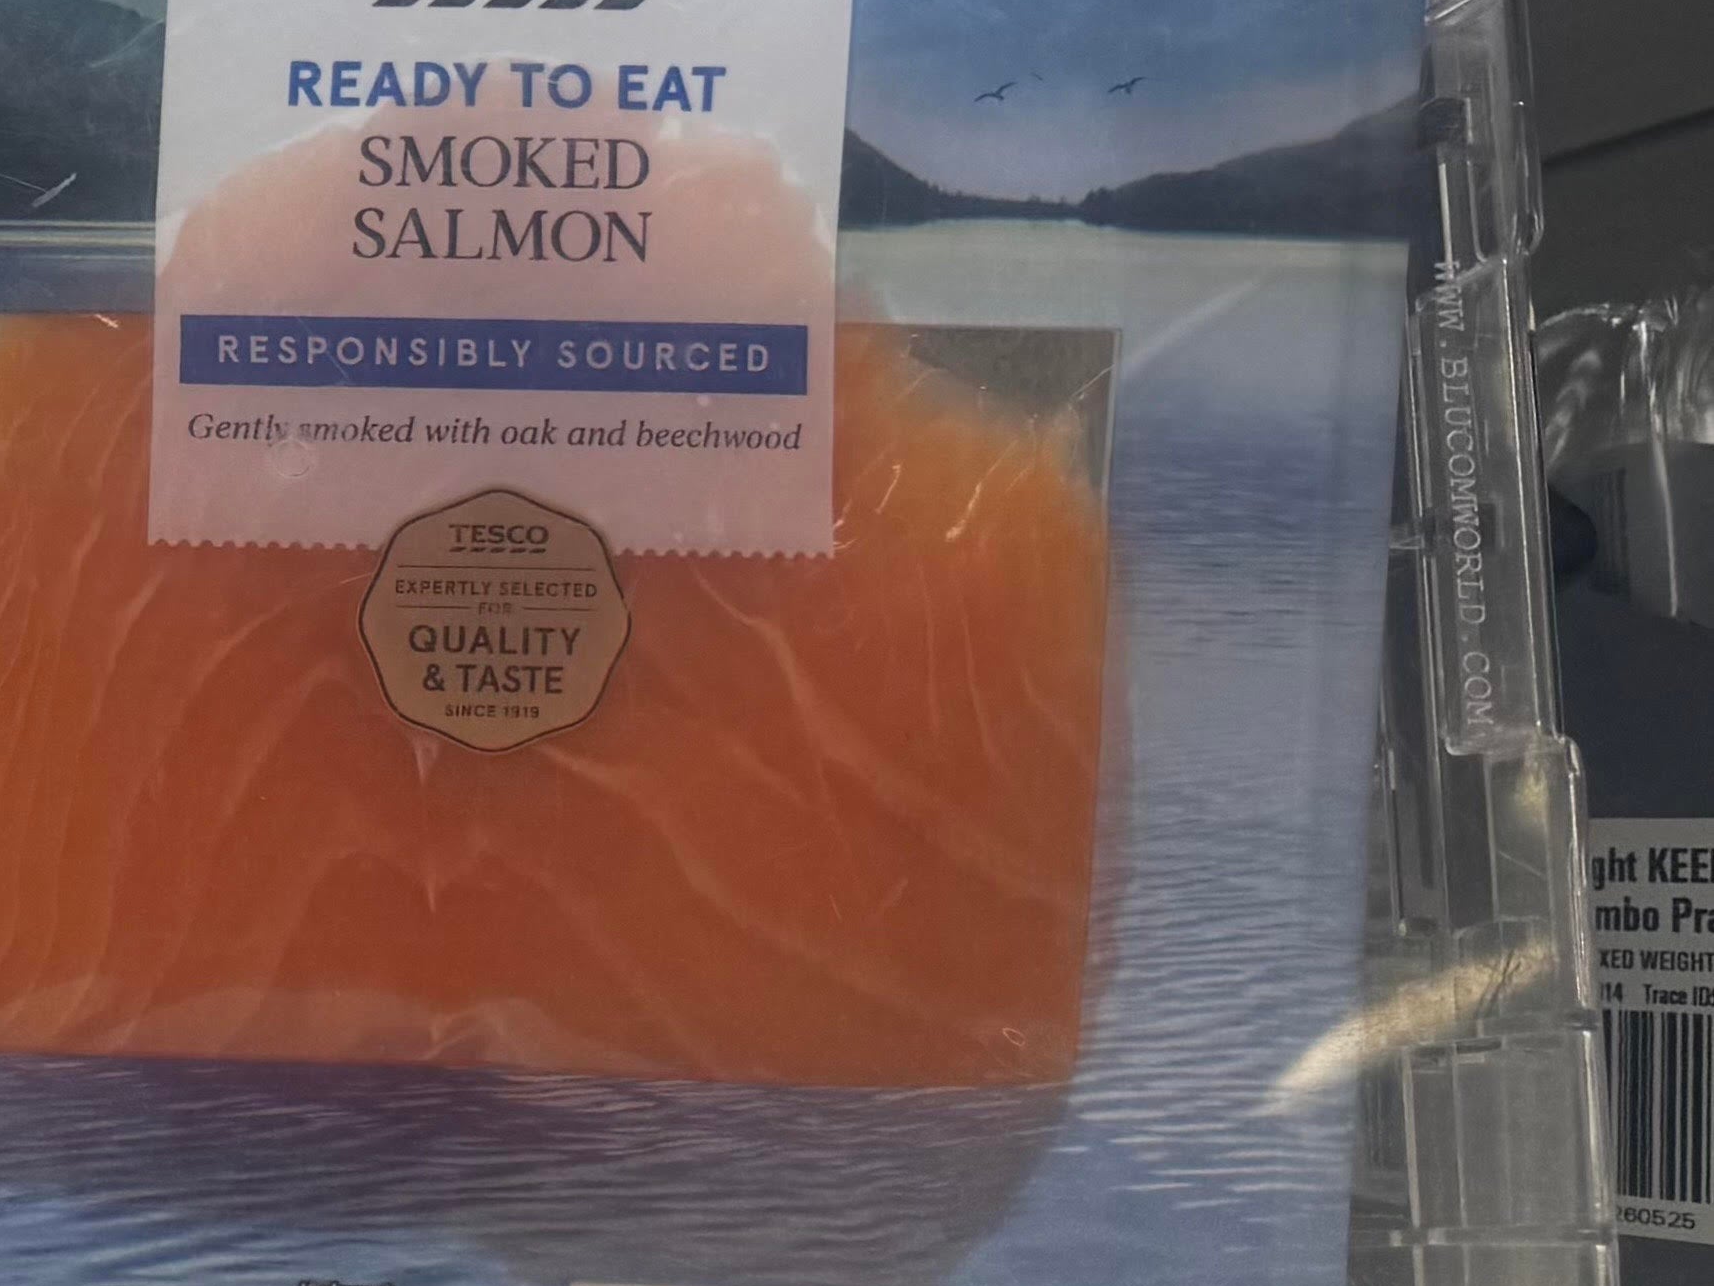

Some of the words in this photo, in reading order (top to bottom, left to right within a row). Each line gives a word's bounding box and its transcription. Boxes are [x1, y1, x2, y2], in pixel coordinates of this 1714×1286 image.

[287, 61, 487, 107] READY
[511, 64, 592, 109] TO
[618, 65, 726, 112] EAT
[359, 135, 650, 189] SMOKED
[352, 208, 652, 263] SALMON
[217, 335, 532, 368] RESPONSIBLY
[557, 340, 771, 372] SOURCED
[188, 413, 289, 446] Gently
[298, 416, 413, 444] smoked
[425, 416, 490, 445] with
[500, 418, 557, 446] oak
[567, 419, 625, 448] and
[636, 420, 802, 452] beechwood
[449, 525, 549, 545] TESCO
[395, 579, 490, 596] EXPERTLY
[499, 581, 598, 598] SELECTED
[478, 603, 514, 616] FOR
[408, 625, 582, 656] QUALITY
[423, 664, 446, 692] &
[456, 664, 565, 694] TASTE
[445, 705, 496, 718] SINCE
[1648, 847, 1714, 883] KEE
[1643, 983, 1688, 1005] Trace
